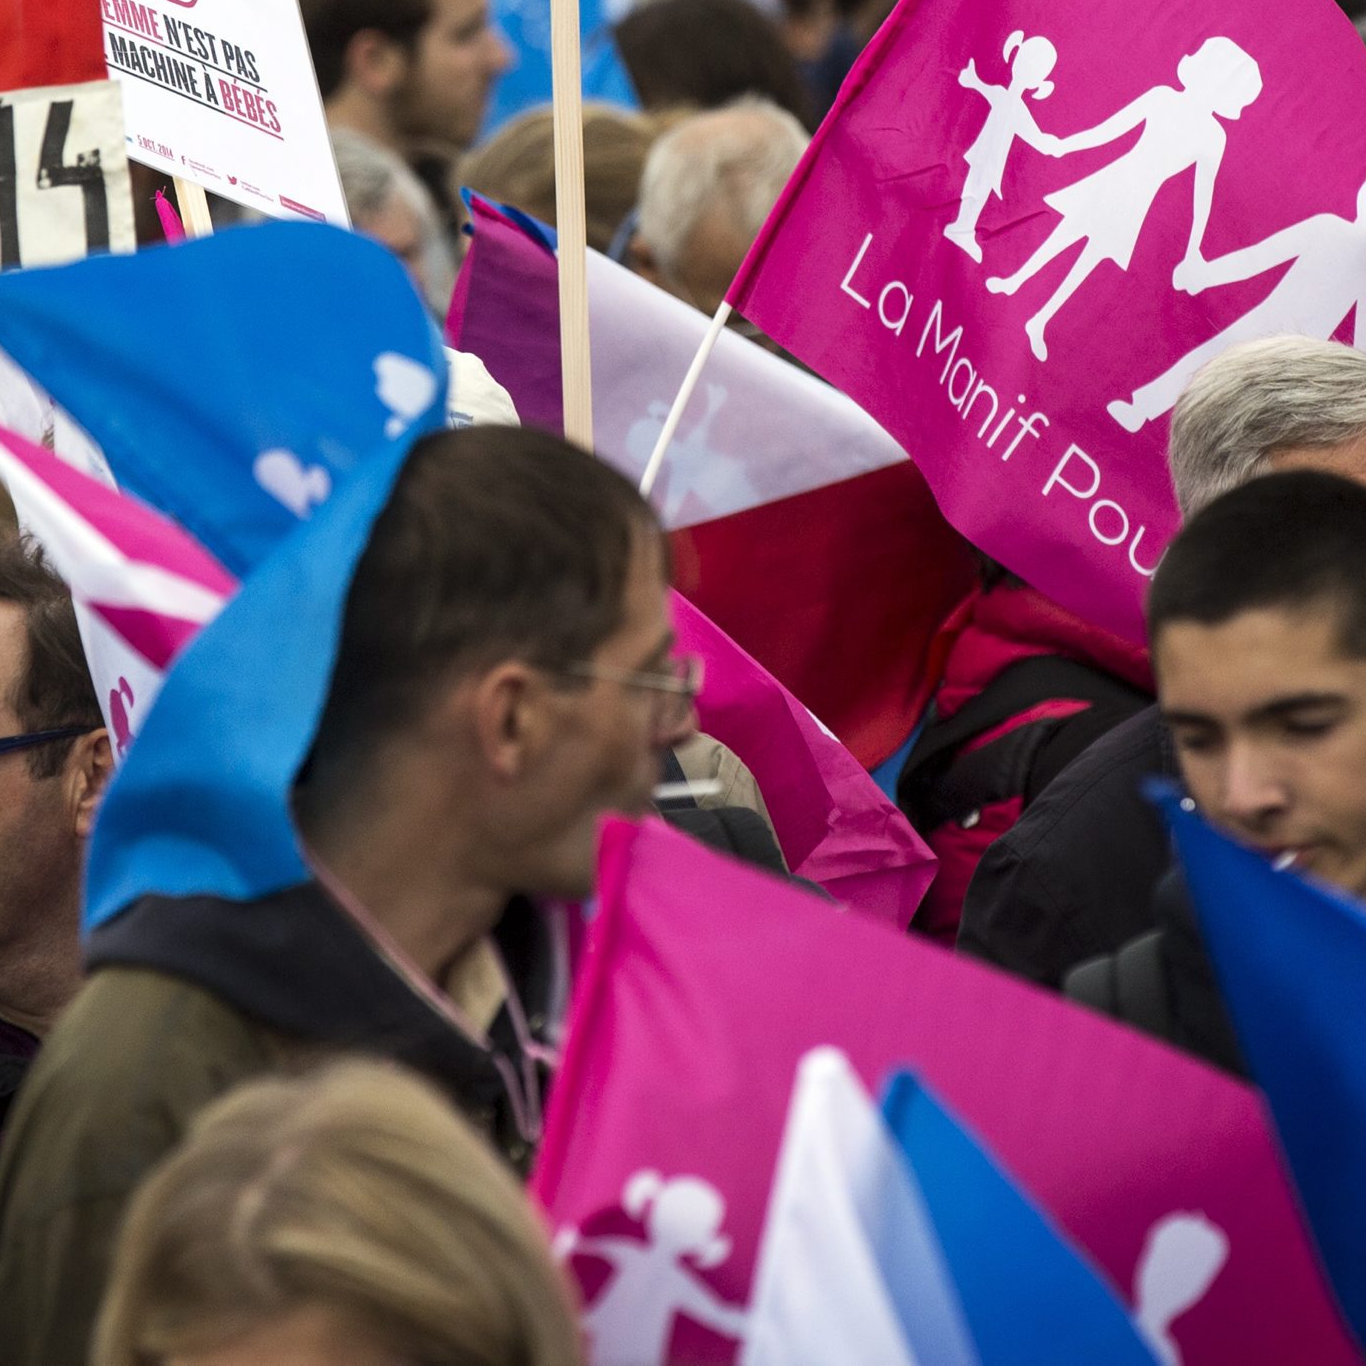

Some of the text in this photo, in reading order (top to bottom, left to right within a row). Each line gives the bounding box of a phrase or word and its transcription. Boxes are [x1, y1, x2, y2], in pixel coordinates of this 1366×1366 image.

[108, 31, 281, 133] MACHINE À BÉBÉS
[163, 13, 218, 65] N'EST
[221, 38, 260, 83] PAS
[158, 143, 174, 158] 2014
[841, 233, 1170, 579] La Manif Pou
